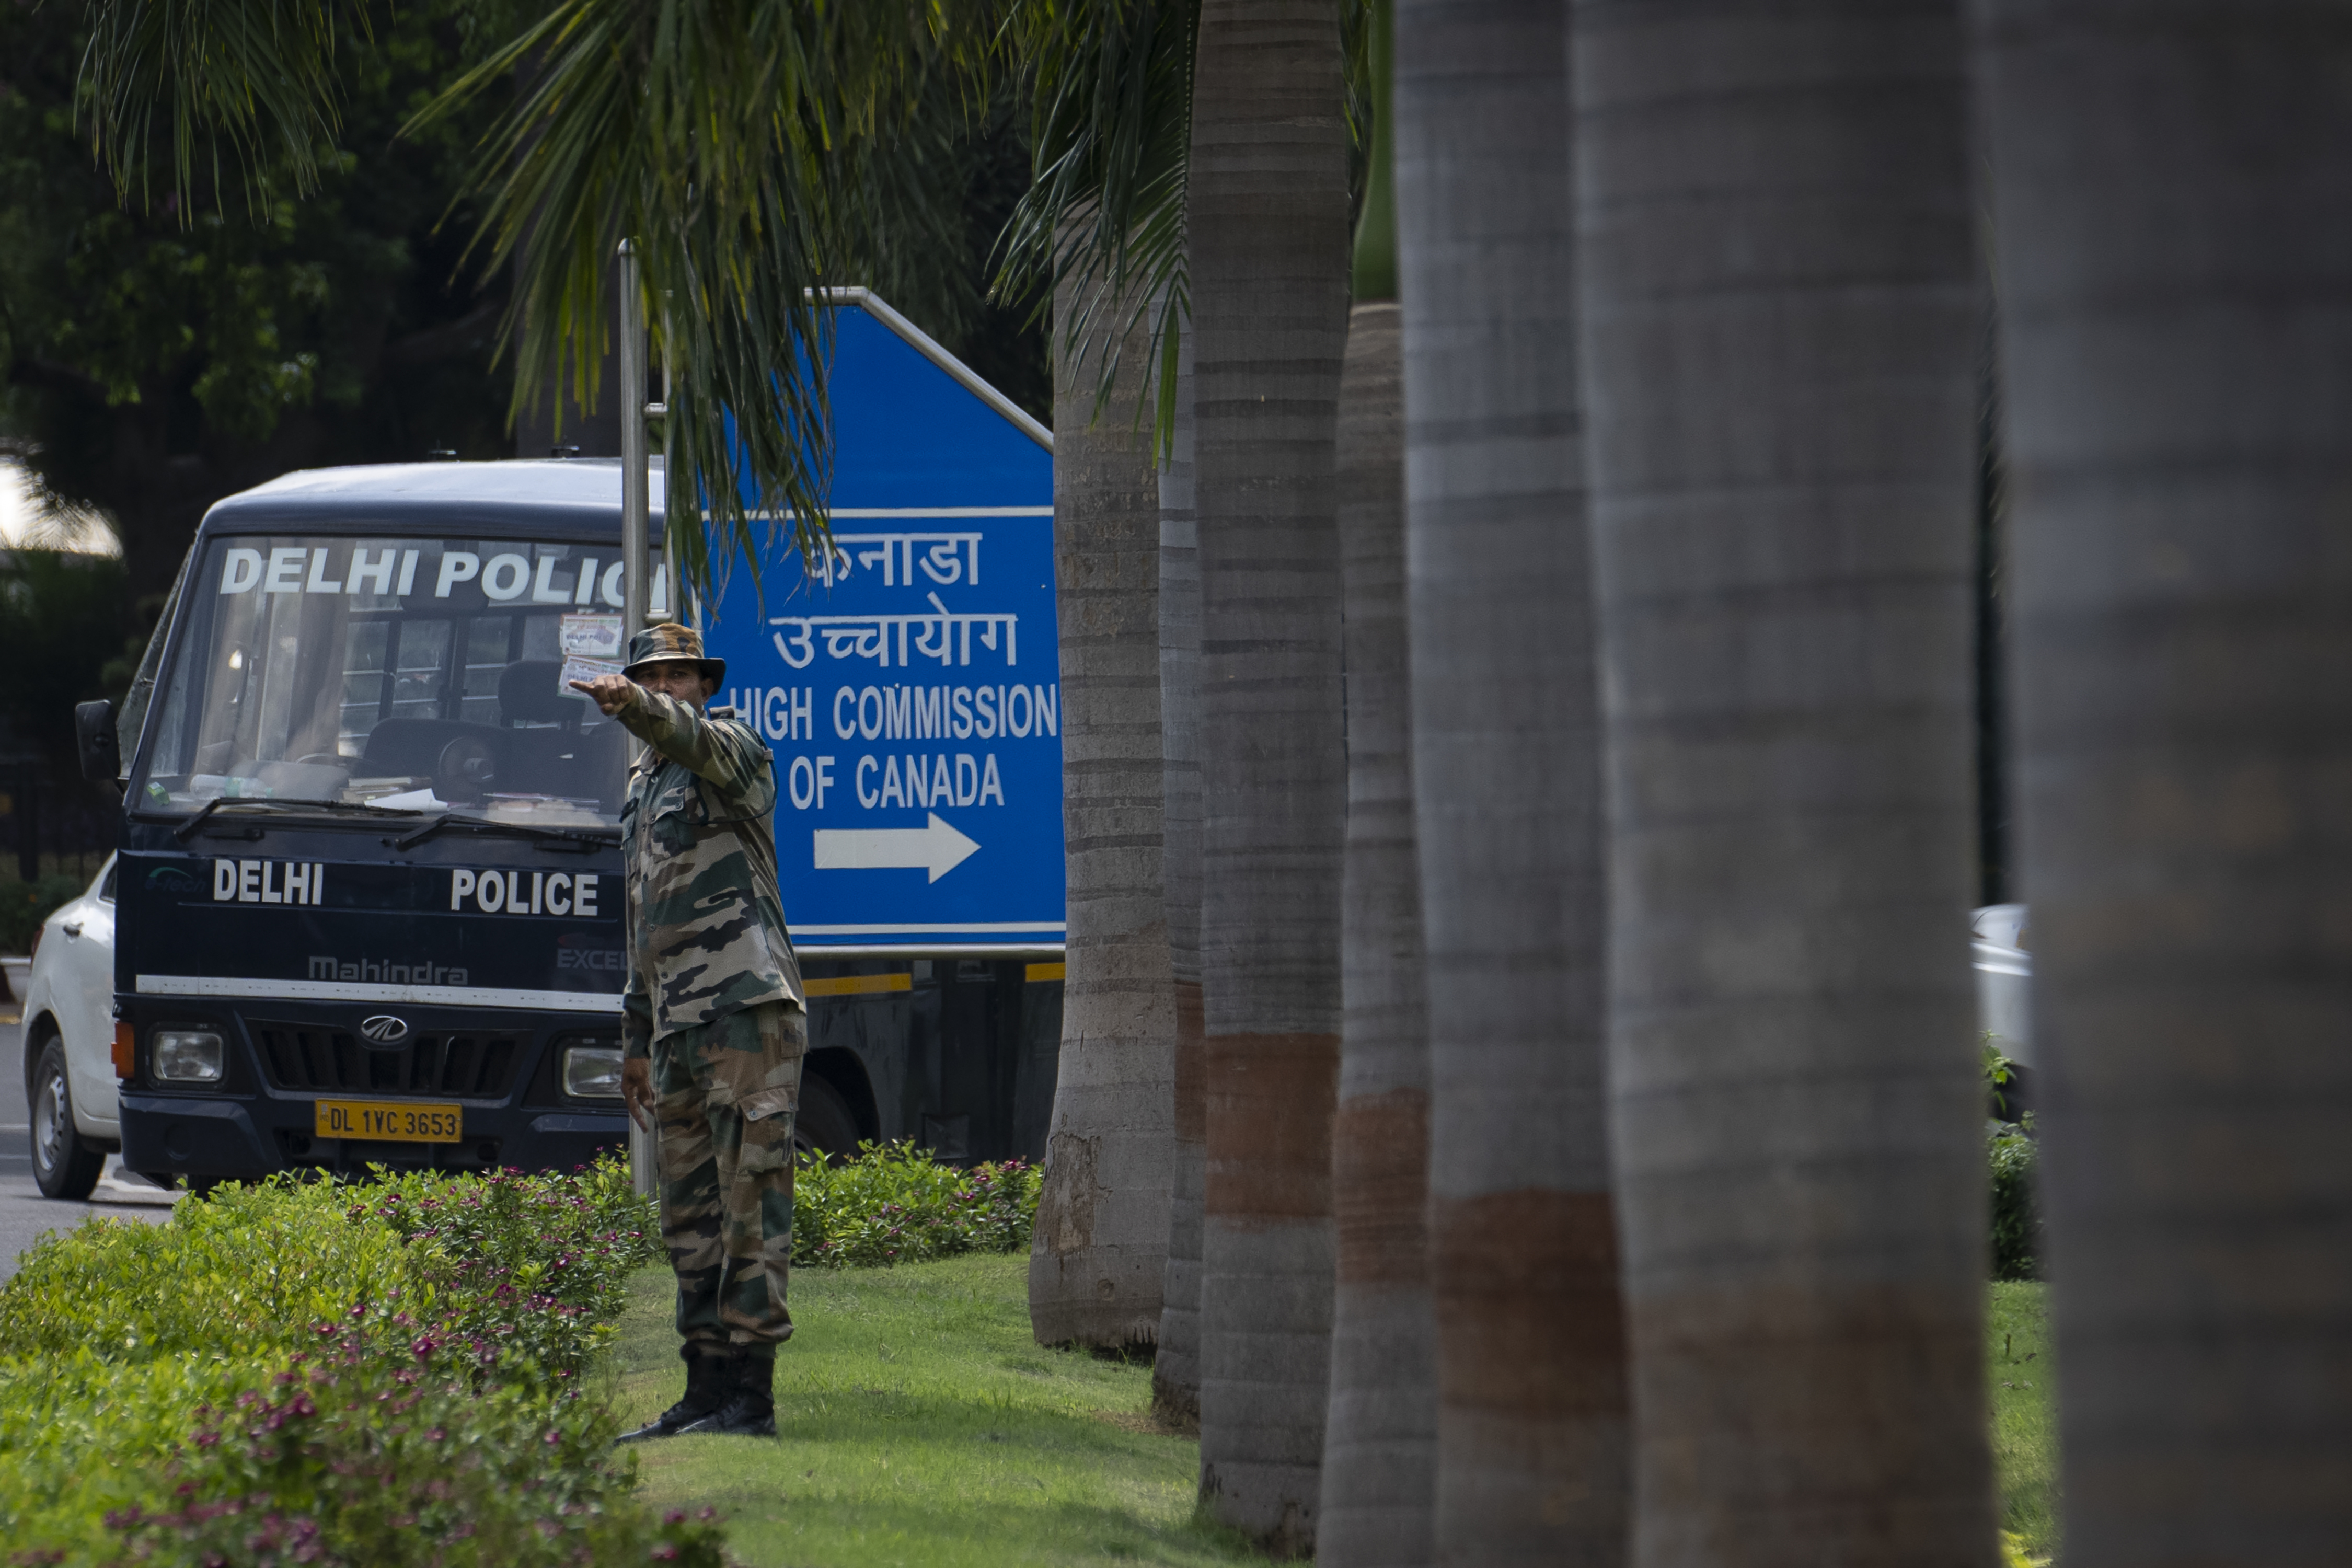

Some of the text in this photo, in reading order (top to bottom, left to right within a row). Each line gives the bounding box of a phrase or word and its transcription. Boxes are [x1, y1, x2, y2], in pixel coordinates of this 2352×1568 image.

[221, 548, 418, 596] DELHI
[805, 533, 983, 587] कनाडा
[769, 591, 1018, 669] उच्चायोग
[730, 684, 1058, 740] HIGH COMMISSION
[789, 754, 1005, 810] OF CANADA
[214, 859, 598, 916] DELHI POLICE
[309, 956, 468, 985] Mahindra
[331, 1108, 456, 1136] DL 1VC 3653
